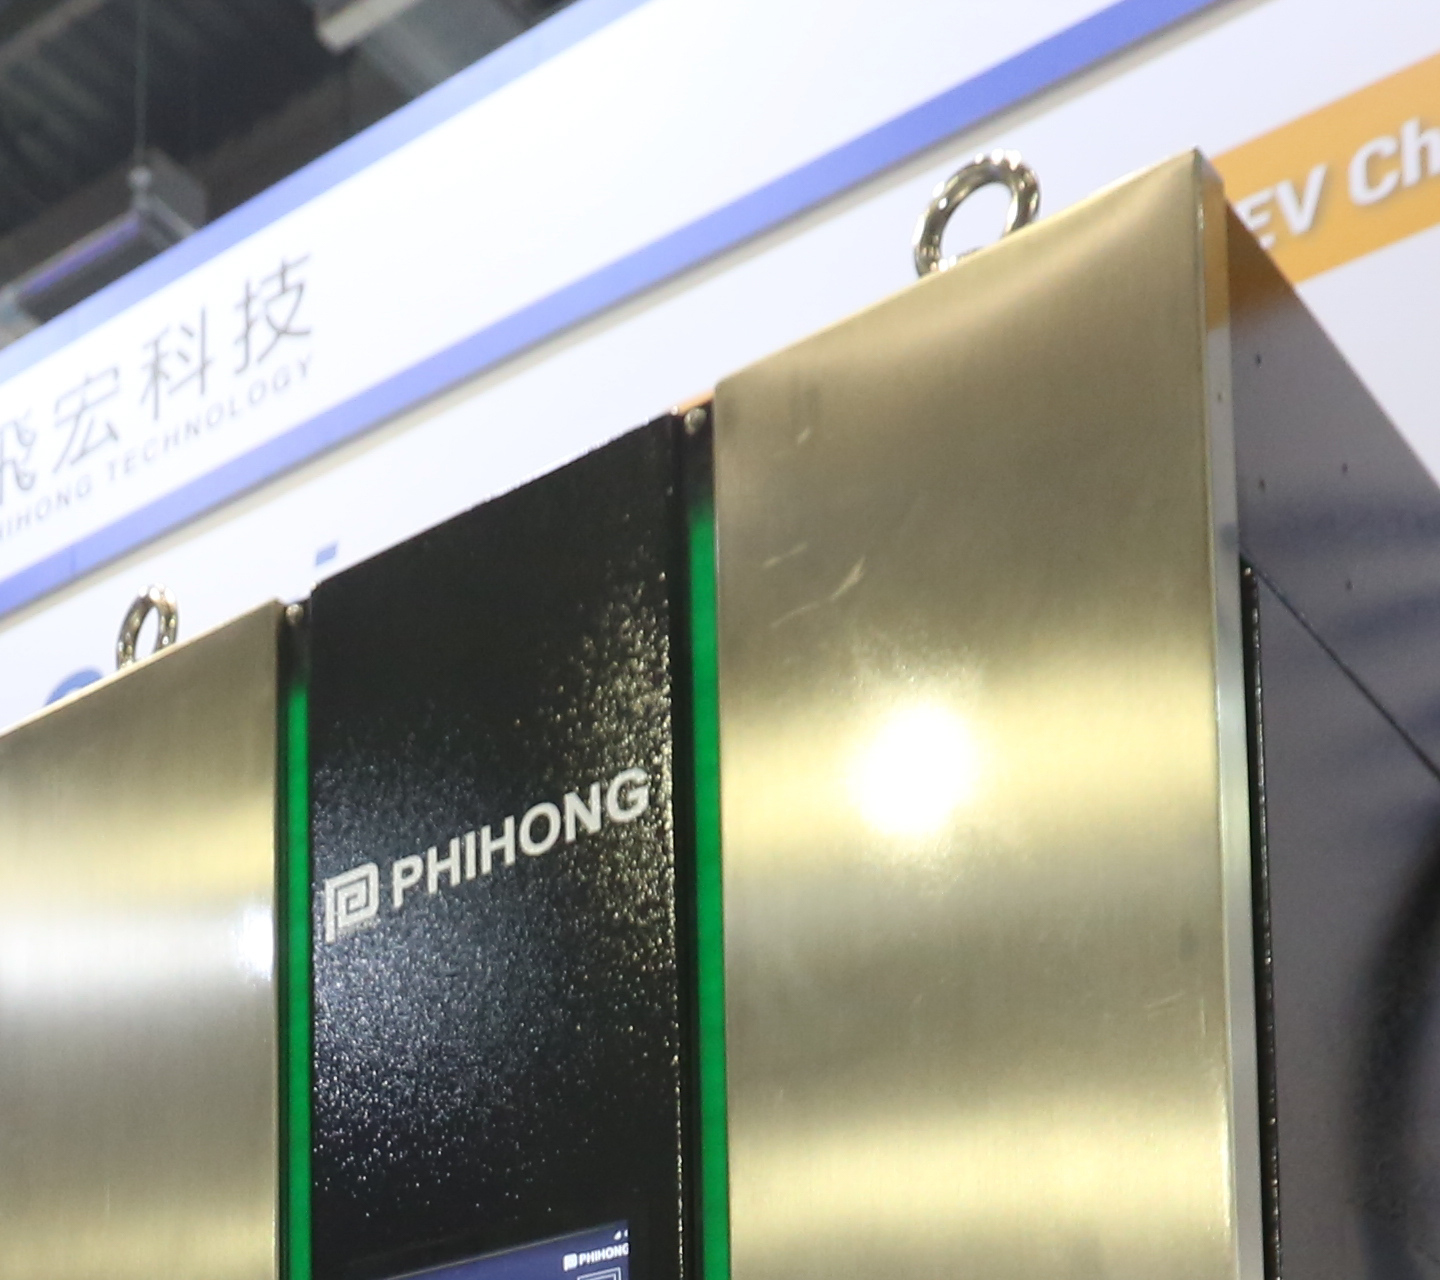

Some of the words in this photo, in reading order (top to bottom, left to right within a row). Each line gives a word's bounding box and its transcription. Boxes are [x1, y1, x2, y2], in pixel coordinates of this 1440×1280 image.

[1240, 162, 1327, 250] EV
[107, 355, 314, 484] TECHNOLOGY
[391, 766, 650, 908] PHIHONG
[578, 1242, 629, 1266] PHIHONG
